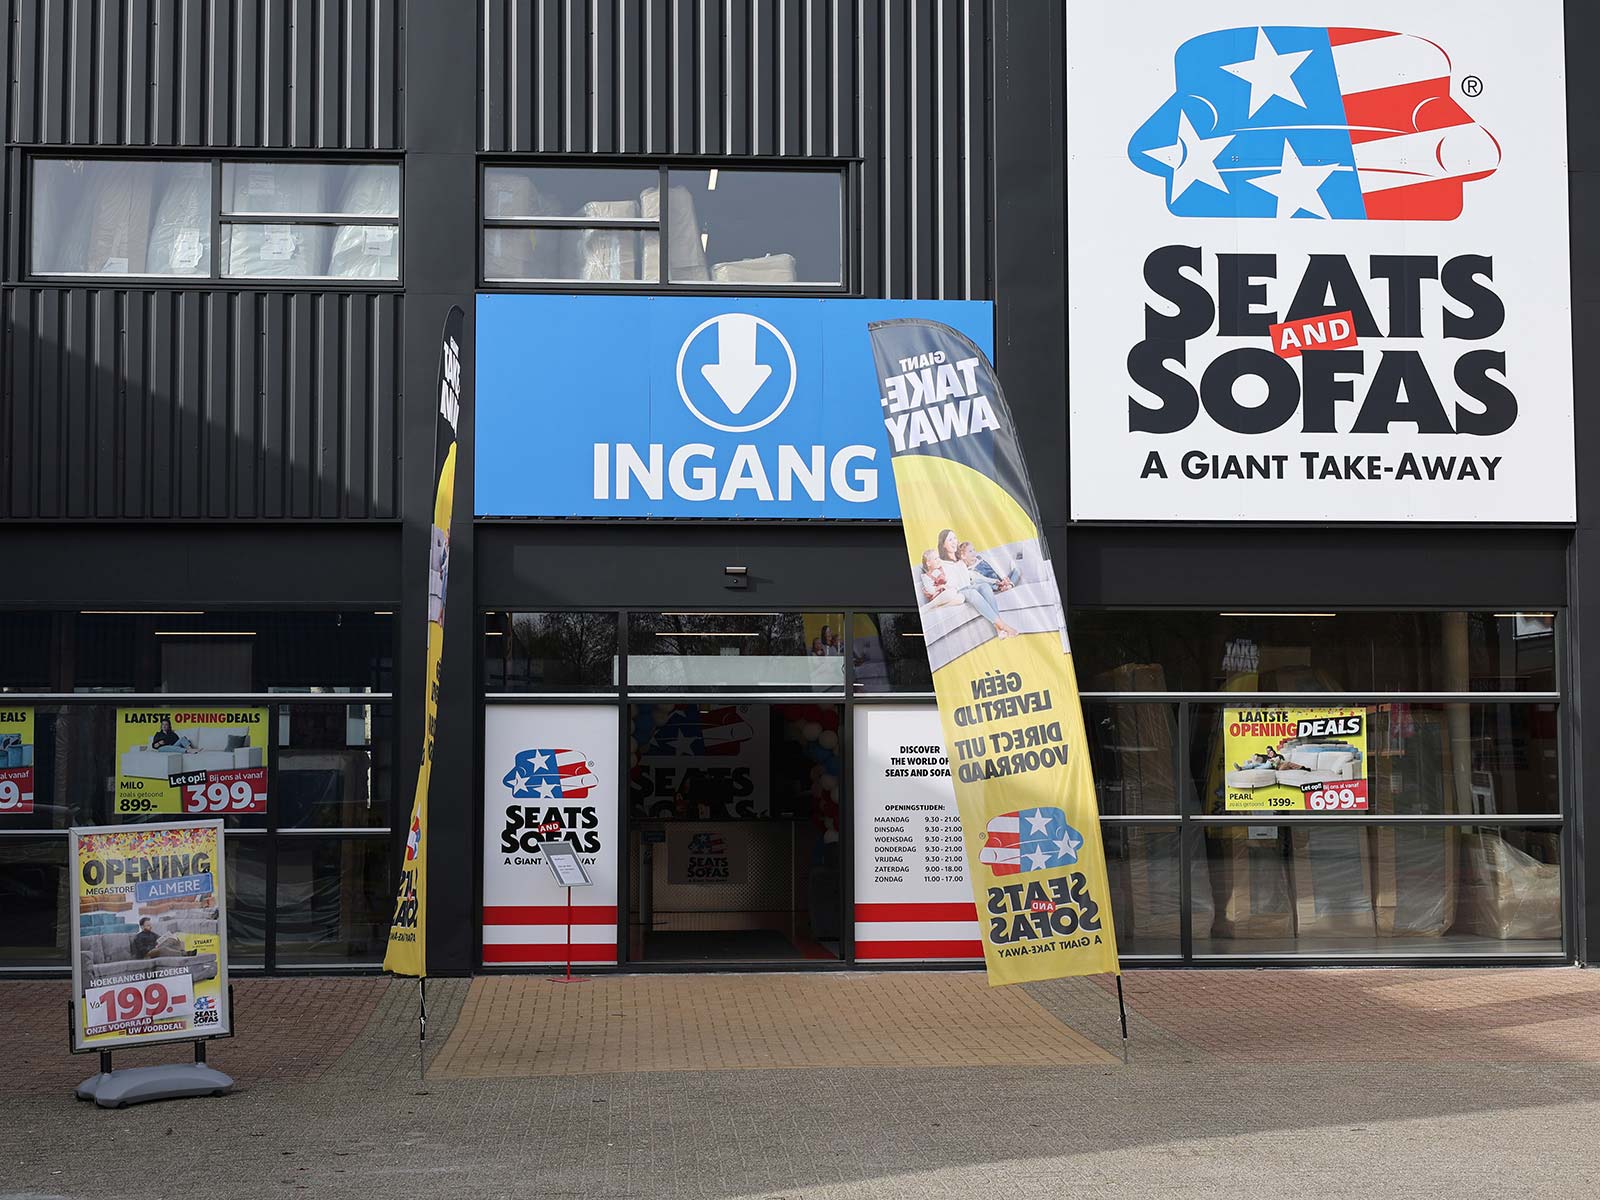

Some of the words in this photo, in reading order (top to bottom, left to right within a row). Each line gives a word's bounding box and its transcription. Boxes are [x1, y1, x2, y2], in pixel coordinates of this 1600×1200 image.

[1143, 244, 1506, 341] SEATS
[1280, 318, 1351, 351] AND
[1127, 338, 1518, 436] SOFAS
[593, 443, 878, 502] INGANG
[1140, 450, 1168, 480] A
[1180, 449, 1289, 481] GIANT
[1299, 451, 1503, 482] TAKE-AWAY
[0, 712, 26, 722] EALS
[1238, 711, 1288, 722] LAATSTE
[1229, 723, 1297, 737] OPENING
[1298, 718, 1360, 737] DEALS
[900, 746, 940, 754] DISCOVER
[890, 757, 906, 766] THE
[907, 757, 938, 766] WORLD
[170, 776, 186, 786] Let
[209, 774, 219, 783] Bij
[220, 774, 234, 782] ons
[242, 771, 264, 779] vanaf
[630, 766, 754, 797] SES
[885, 769, 909, 777] SEATS
[910, 769, 928, 777] AND
[930, 769, 952, 777] SOFA
[120, 781, 144, 789] MILO
[506, 805, 598, 830] SEATS
[540, 823, 559, 832] AND
[82, 852, 211, 886] OPENING
[504, 857, 512, 865] A
[514, 857, 542, 865] GIANT
[86, 885, 135, 895] MEGASTORE
[149, 880, 200, 897] ALMERE
[90, 972, 146, 988] HOEKBANKEN
[146, 966, 189, 979] UITZOEKEN
[86, 1026, 107, 1036] ONZE
[108, 1017, 152, 1031] VOORRAAD
[128, 1027, 141, 1035] UW
[143, 1022, 183, 1033] VOORDEAL
